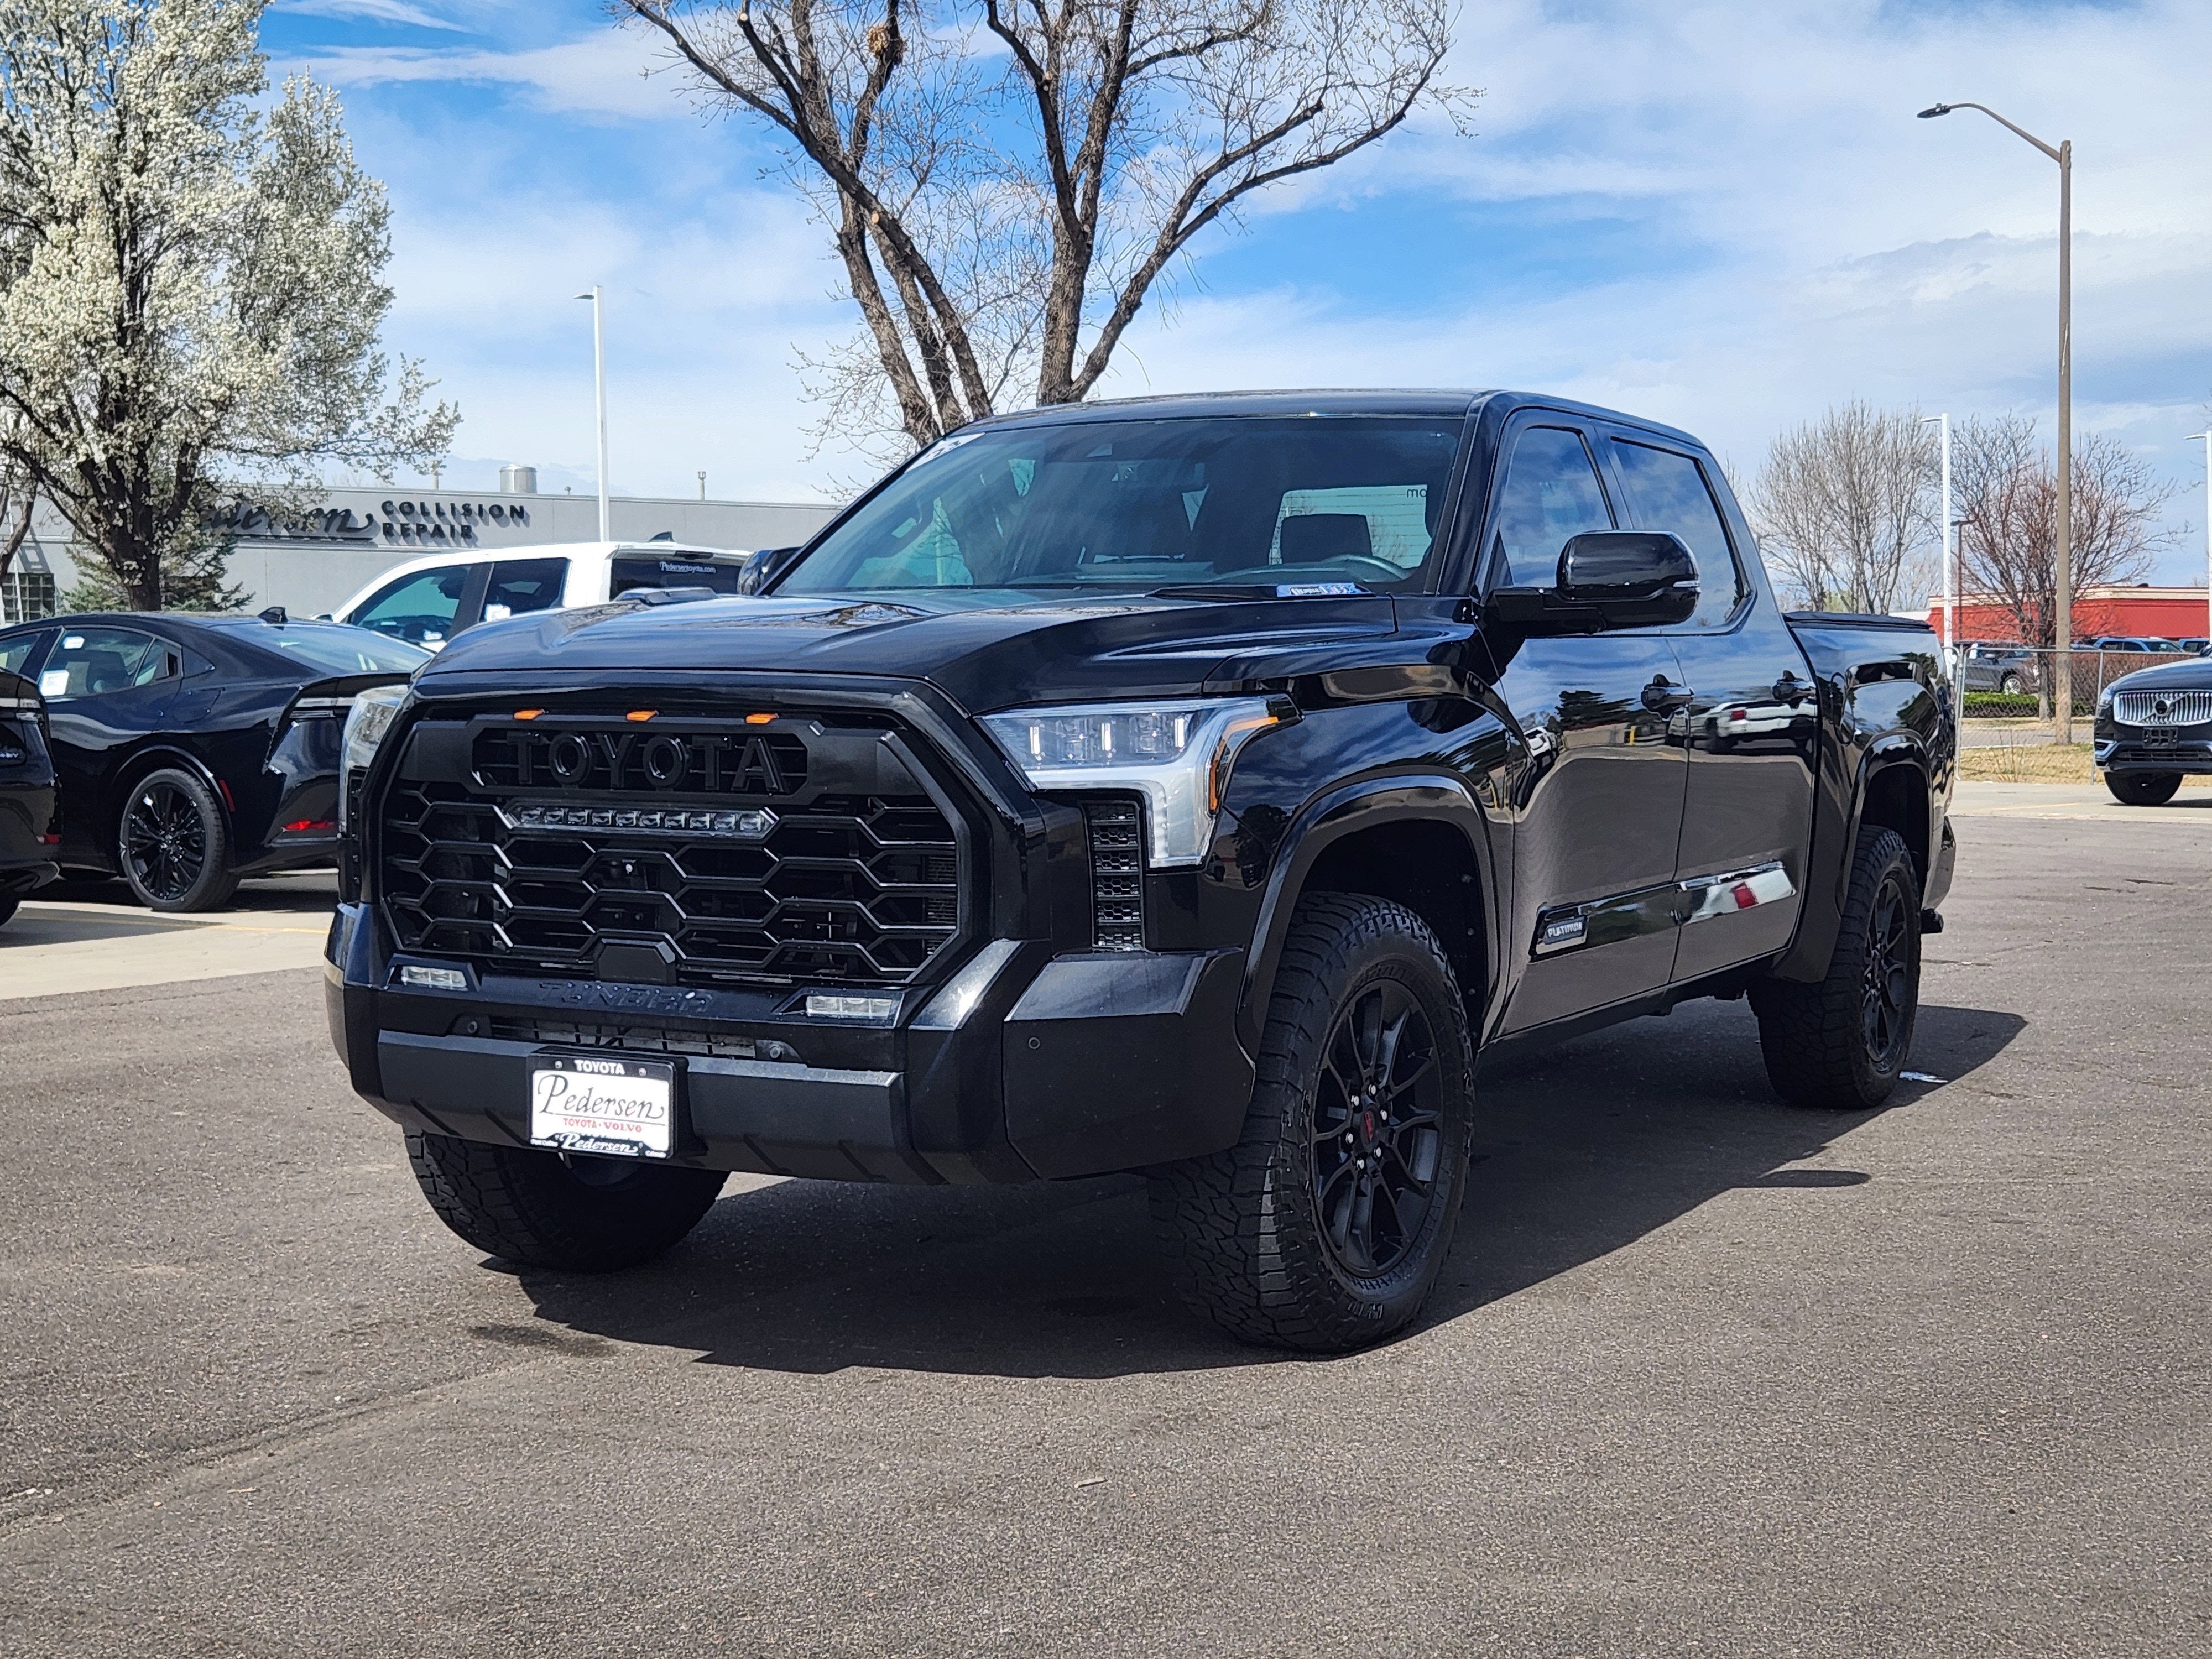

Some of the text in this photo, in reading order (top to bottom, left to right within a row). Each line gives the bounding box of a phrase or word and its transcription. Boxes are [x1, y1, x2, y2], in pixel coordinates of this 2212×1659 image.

[381, 500, 525, 520] COLLISION
[382, 522, 472, 539] REPAIR
[506, 730, 786, 793] TOYOTA
[1547, 921, 1583, 938] PLATINUM
[539, 983, 713, 1013] TUNDRA
[573, 1059, 625, 1075] TOYOTA
[538, 1074, 665, 1119] Pedersen
[563, 1117, 643, 1133] TOYOTA VOLVO
[559, 1132, 639, 1154] Pedersen
